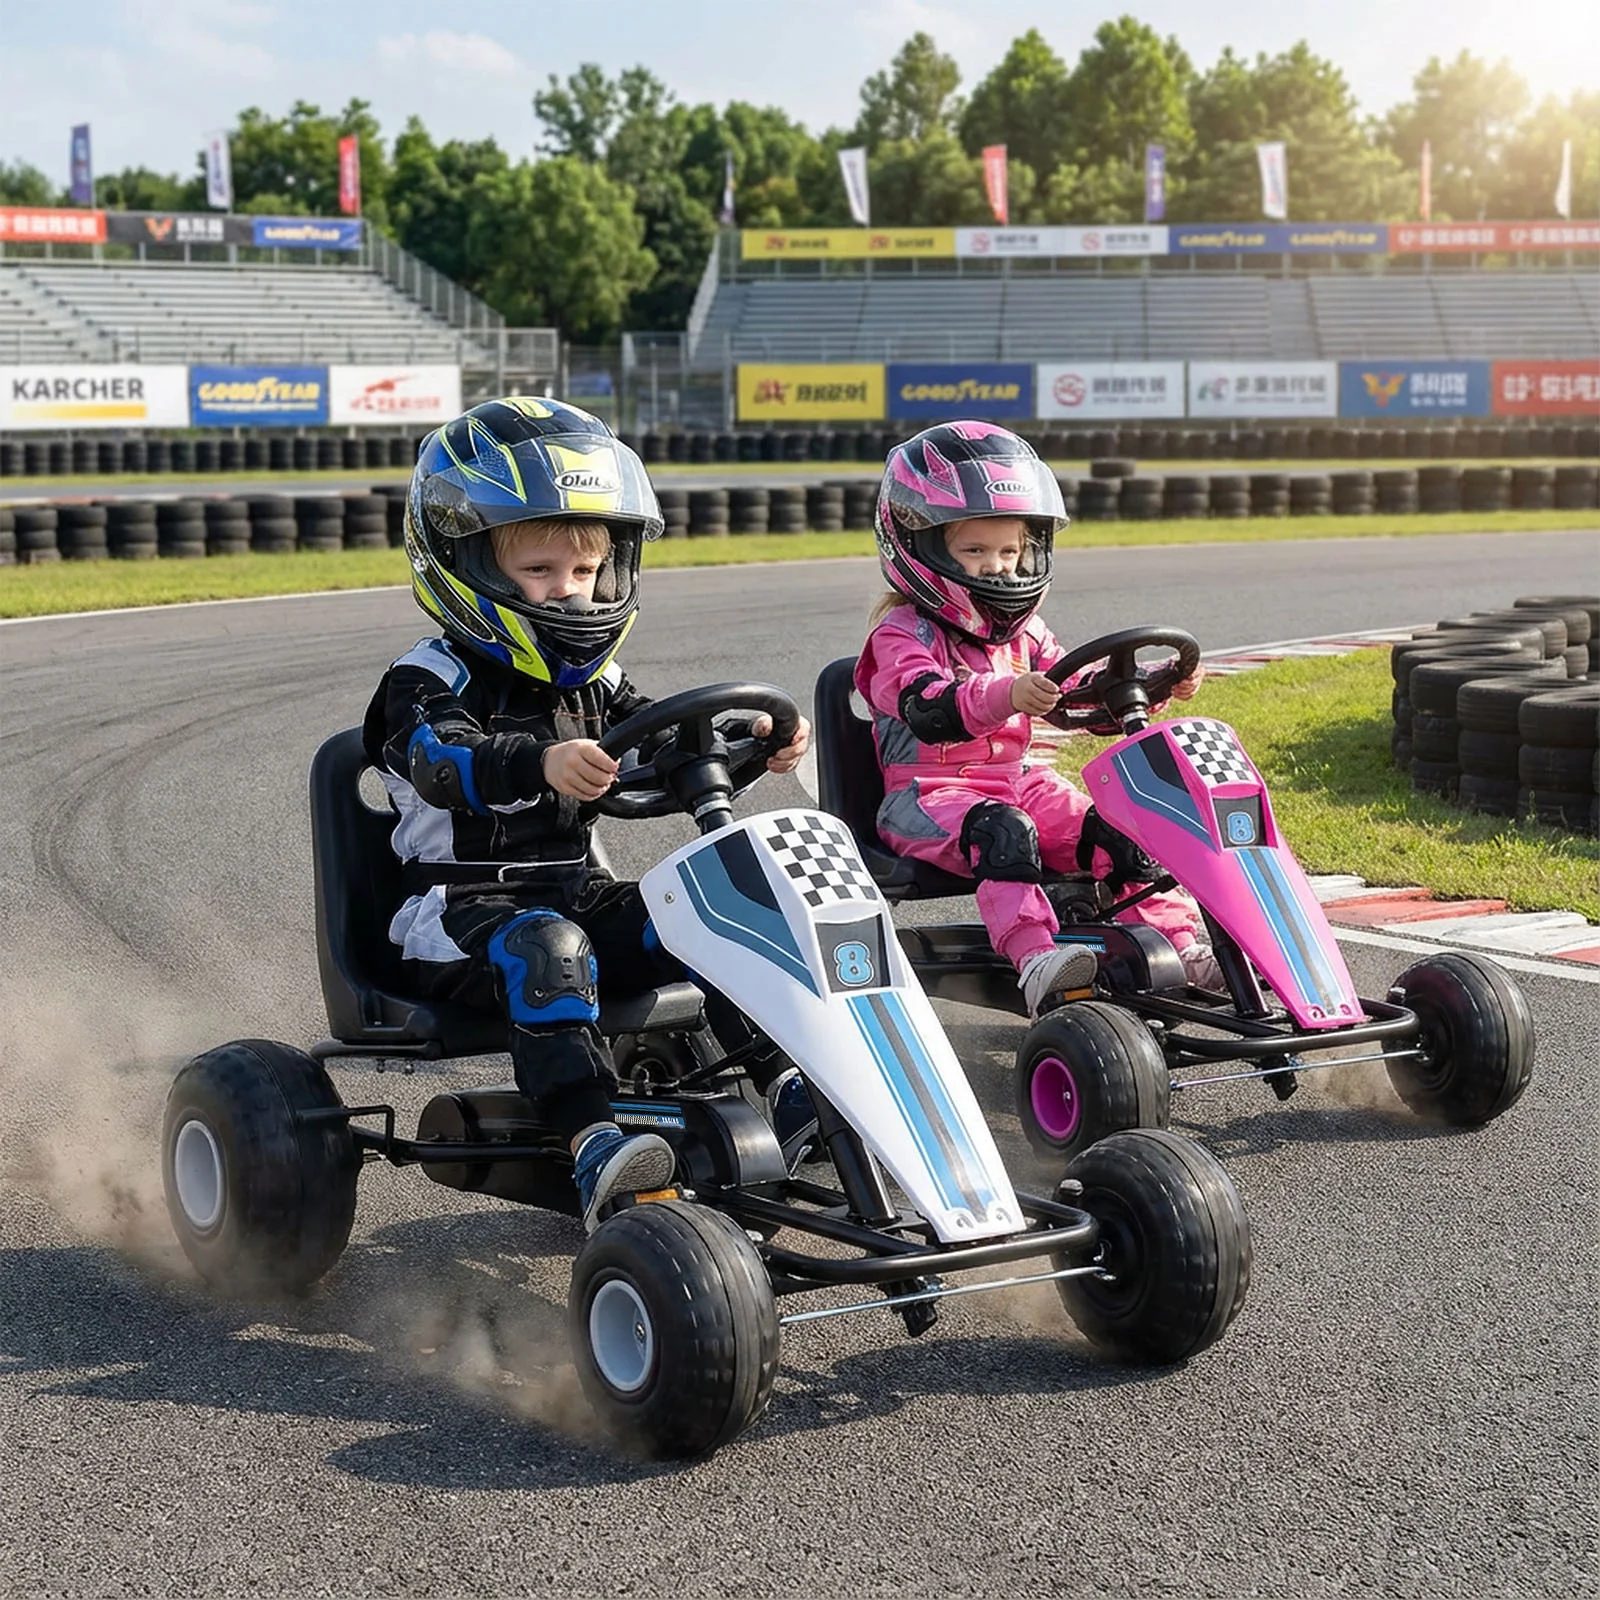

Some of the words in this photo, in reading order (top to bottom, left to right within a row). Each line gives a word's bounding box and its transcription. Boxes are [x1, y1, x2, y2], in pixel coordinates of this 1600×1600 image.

[12, 377, 145, 400] KARCHER
[1227, 811, 1256, 844] 8
[833, 940, 874, 987] 8
